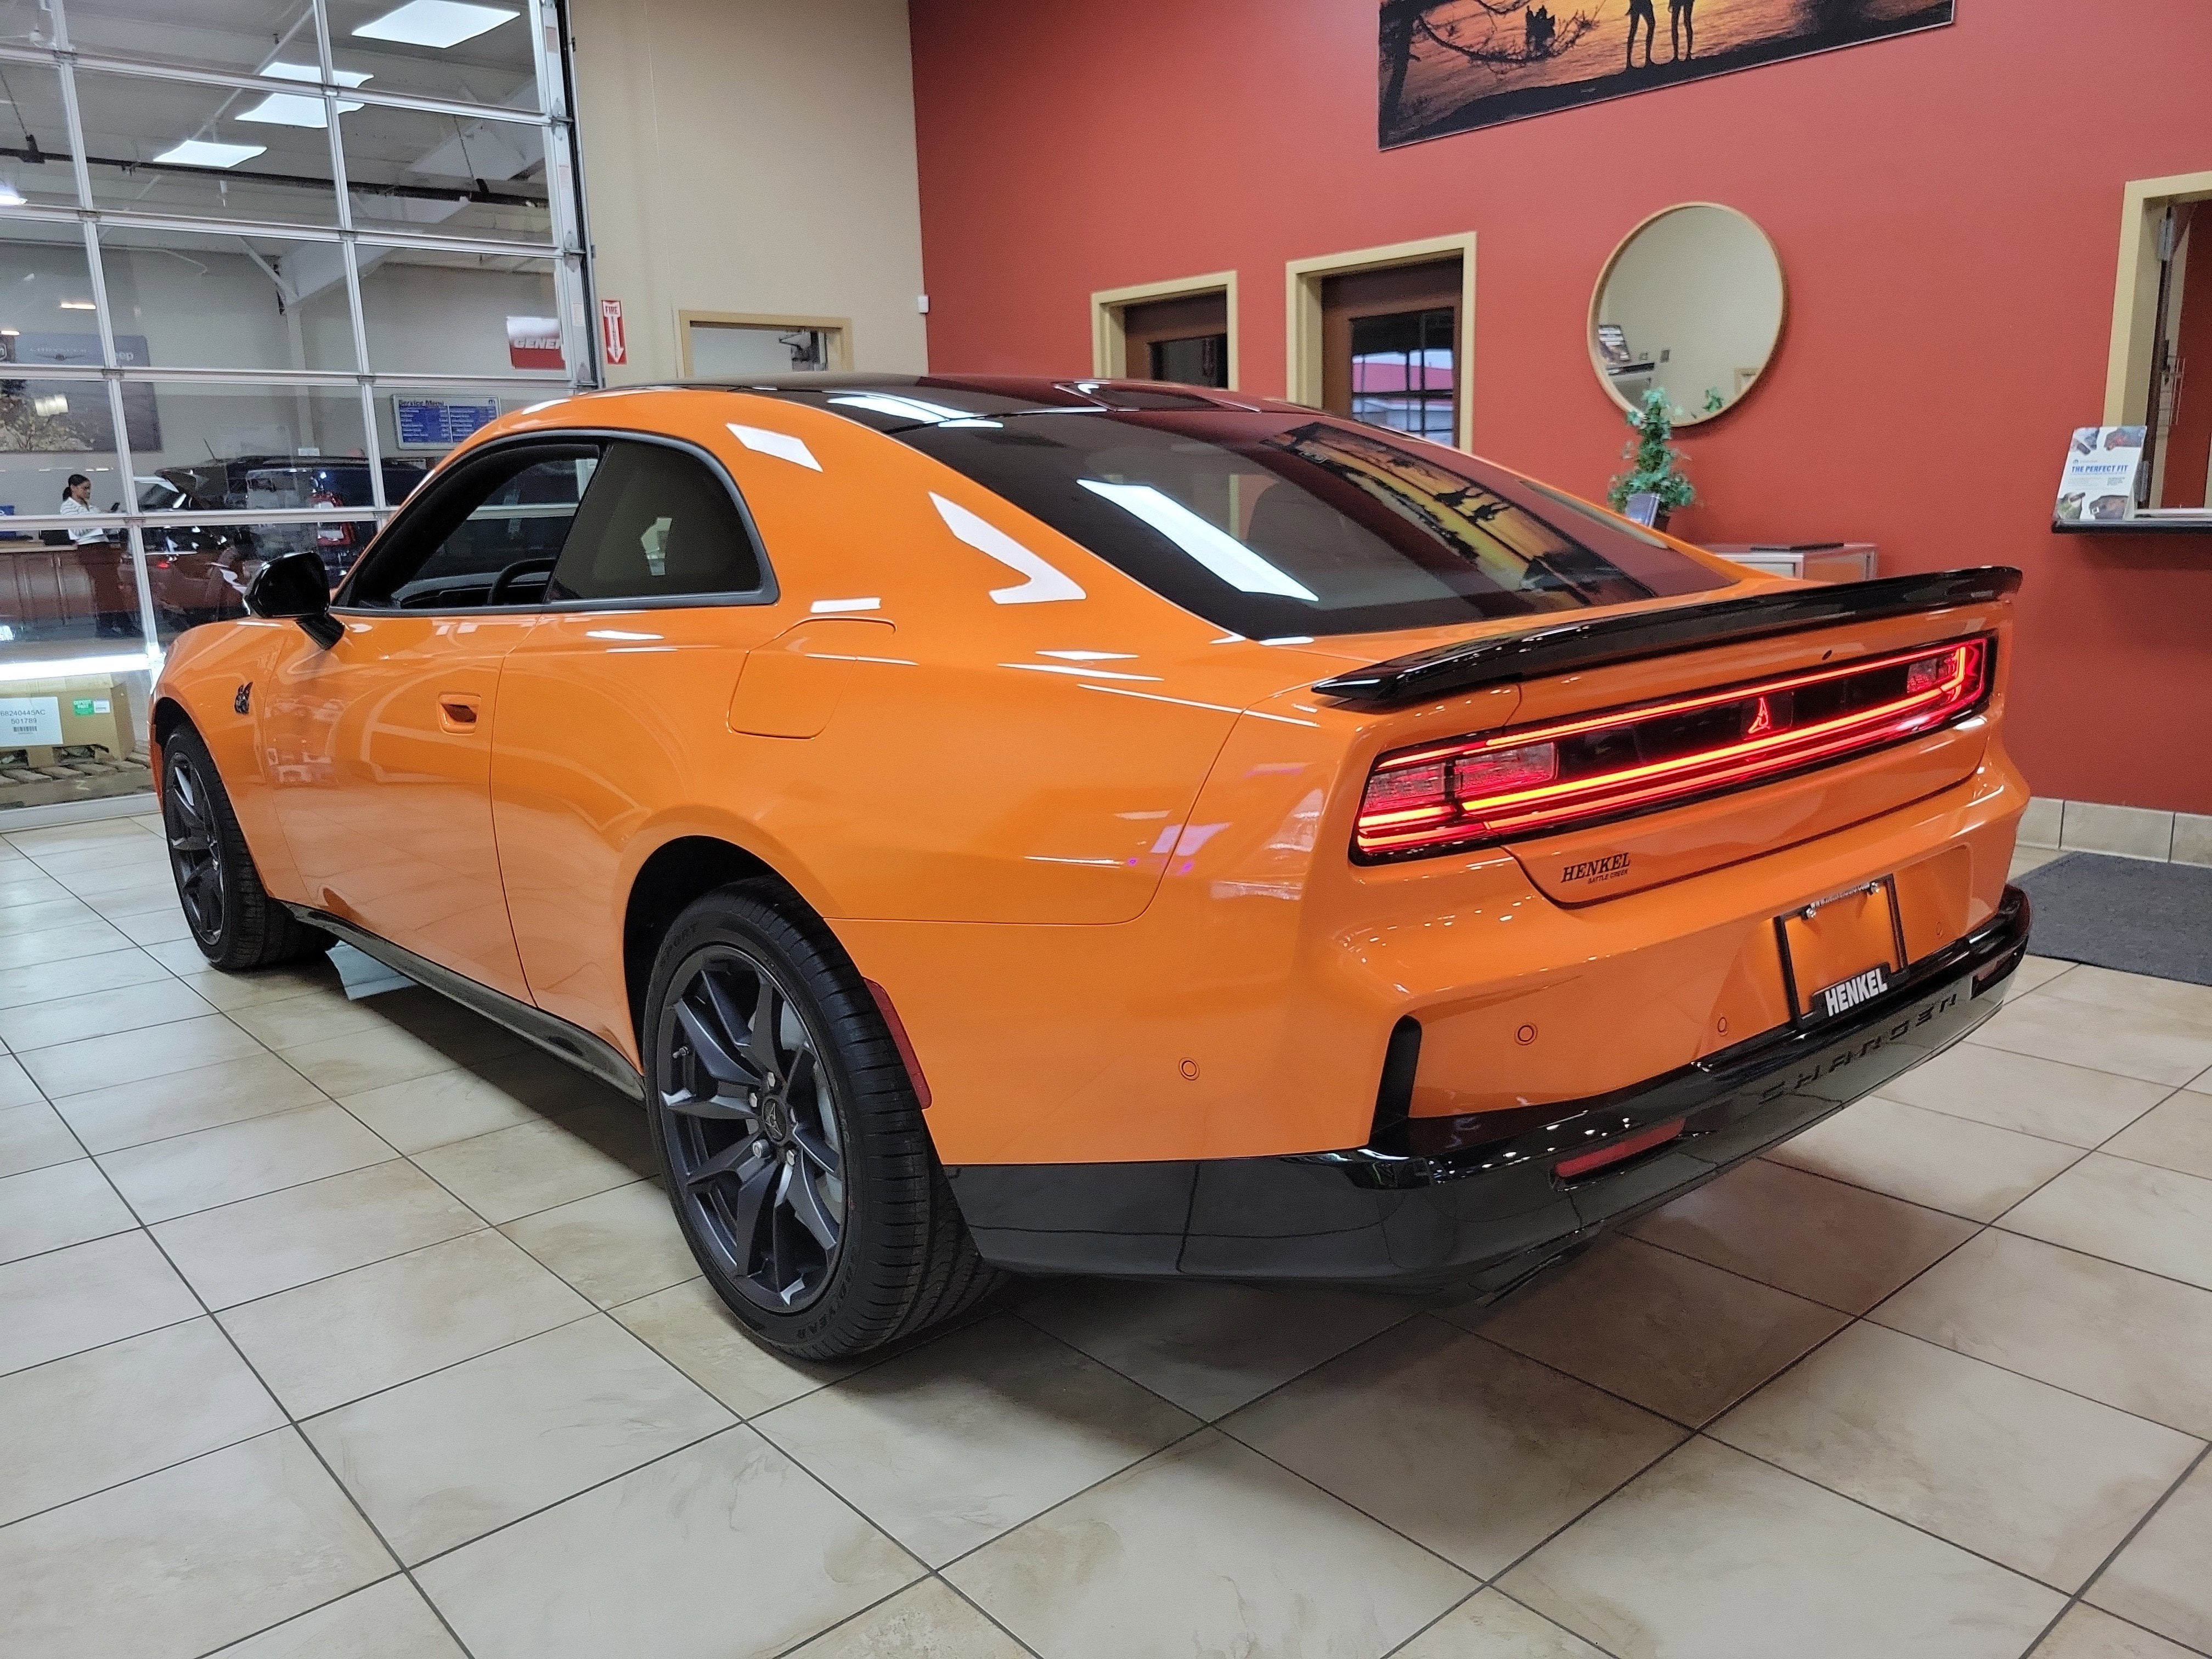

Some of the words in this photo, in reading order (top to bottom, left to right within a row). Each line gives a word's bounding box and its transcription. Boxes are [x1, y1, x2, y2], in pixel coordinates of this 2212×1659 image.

[605, 306, 618, 314] FIRE
[1560, 852, 1631, 883] HENKEL
[1825, 968, 1888, 1017] HENKEL
[1759, 994, 1956, 1104] CHARGER
